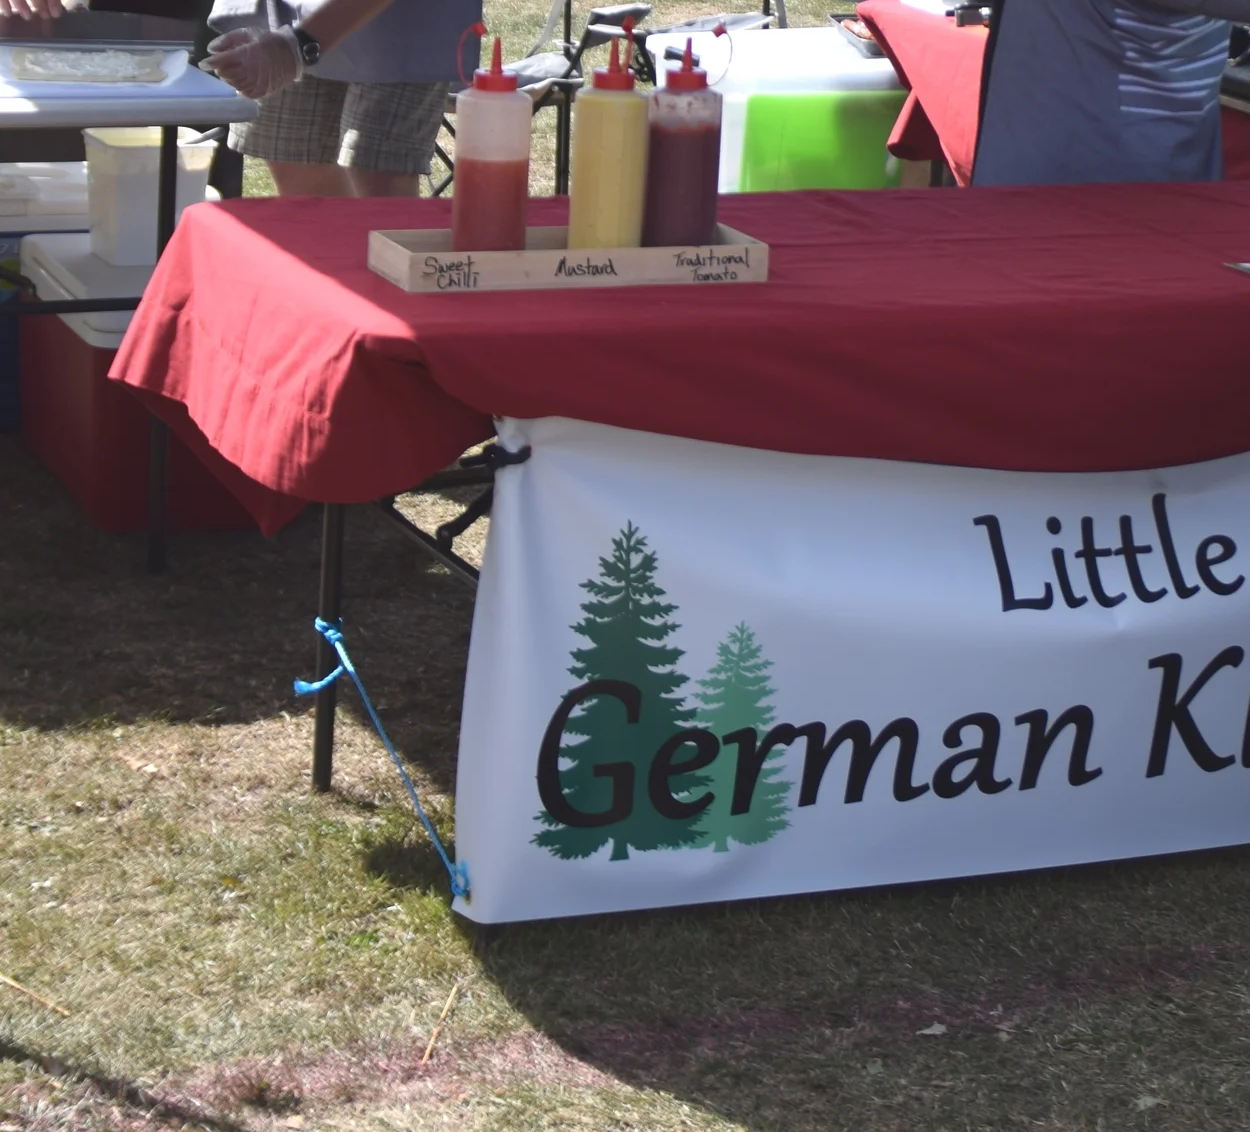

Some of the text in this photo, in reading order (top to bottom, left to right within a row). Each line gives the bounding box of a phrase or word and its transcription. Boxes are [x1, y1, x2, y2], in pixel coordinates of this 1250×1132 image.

[422, 255, 477, 276] Sweet
[555, 257, 618, 278] Mustard
[673, 247, 750, 270] Traditional
[437, 272, 479, 290] Chilli
[690, 267, 739, 283] Tomato
[973, 492, 1246, 614] Little
[536, 678, 1104, 830] German
